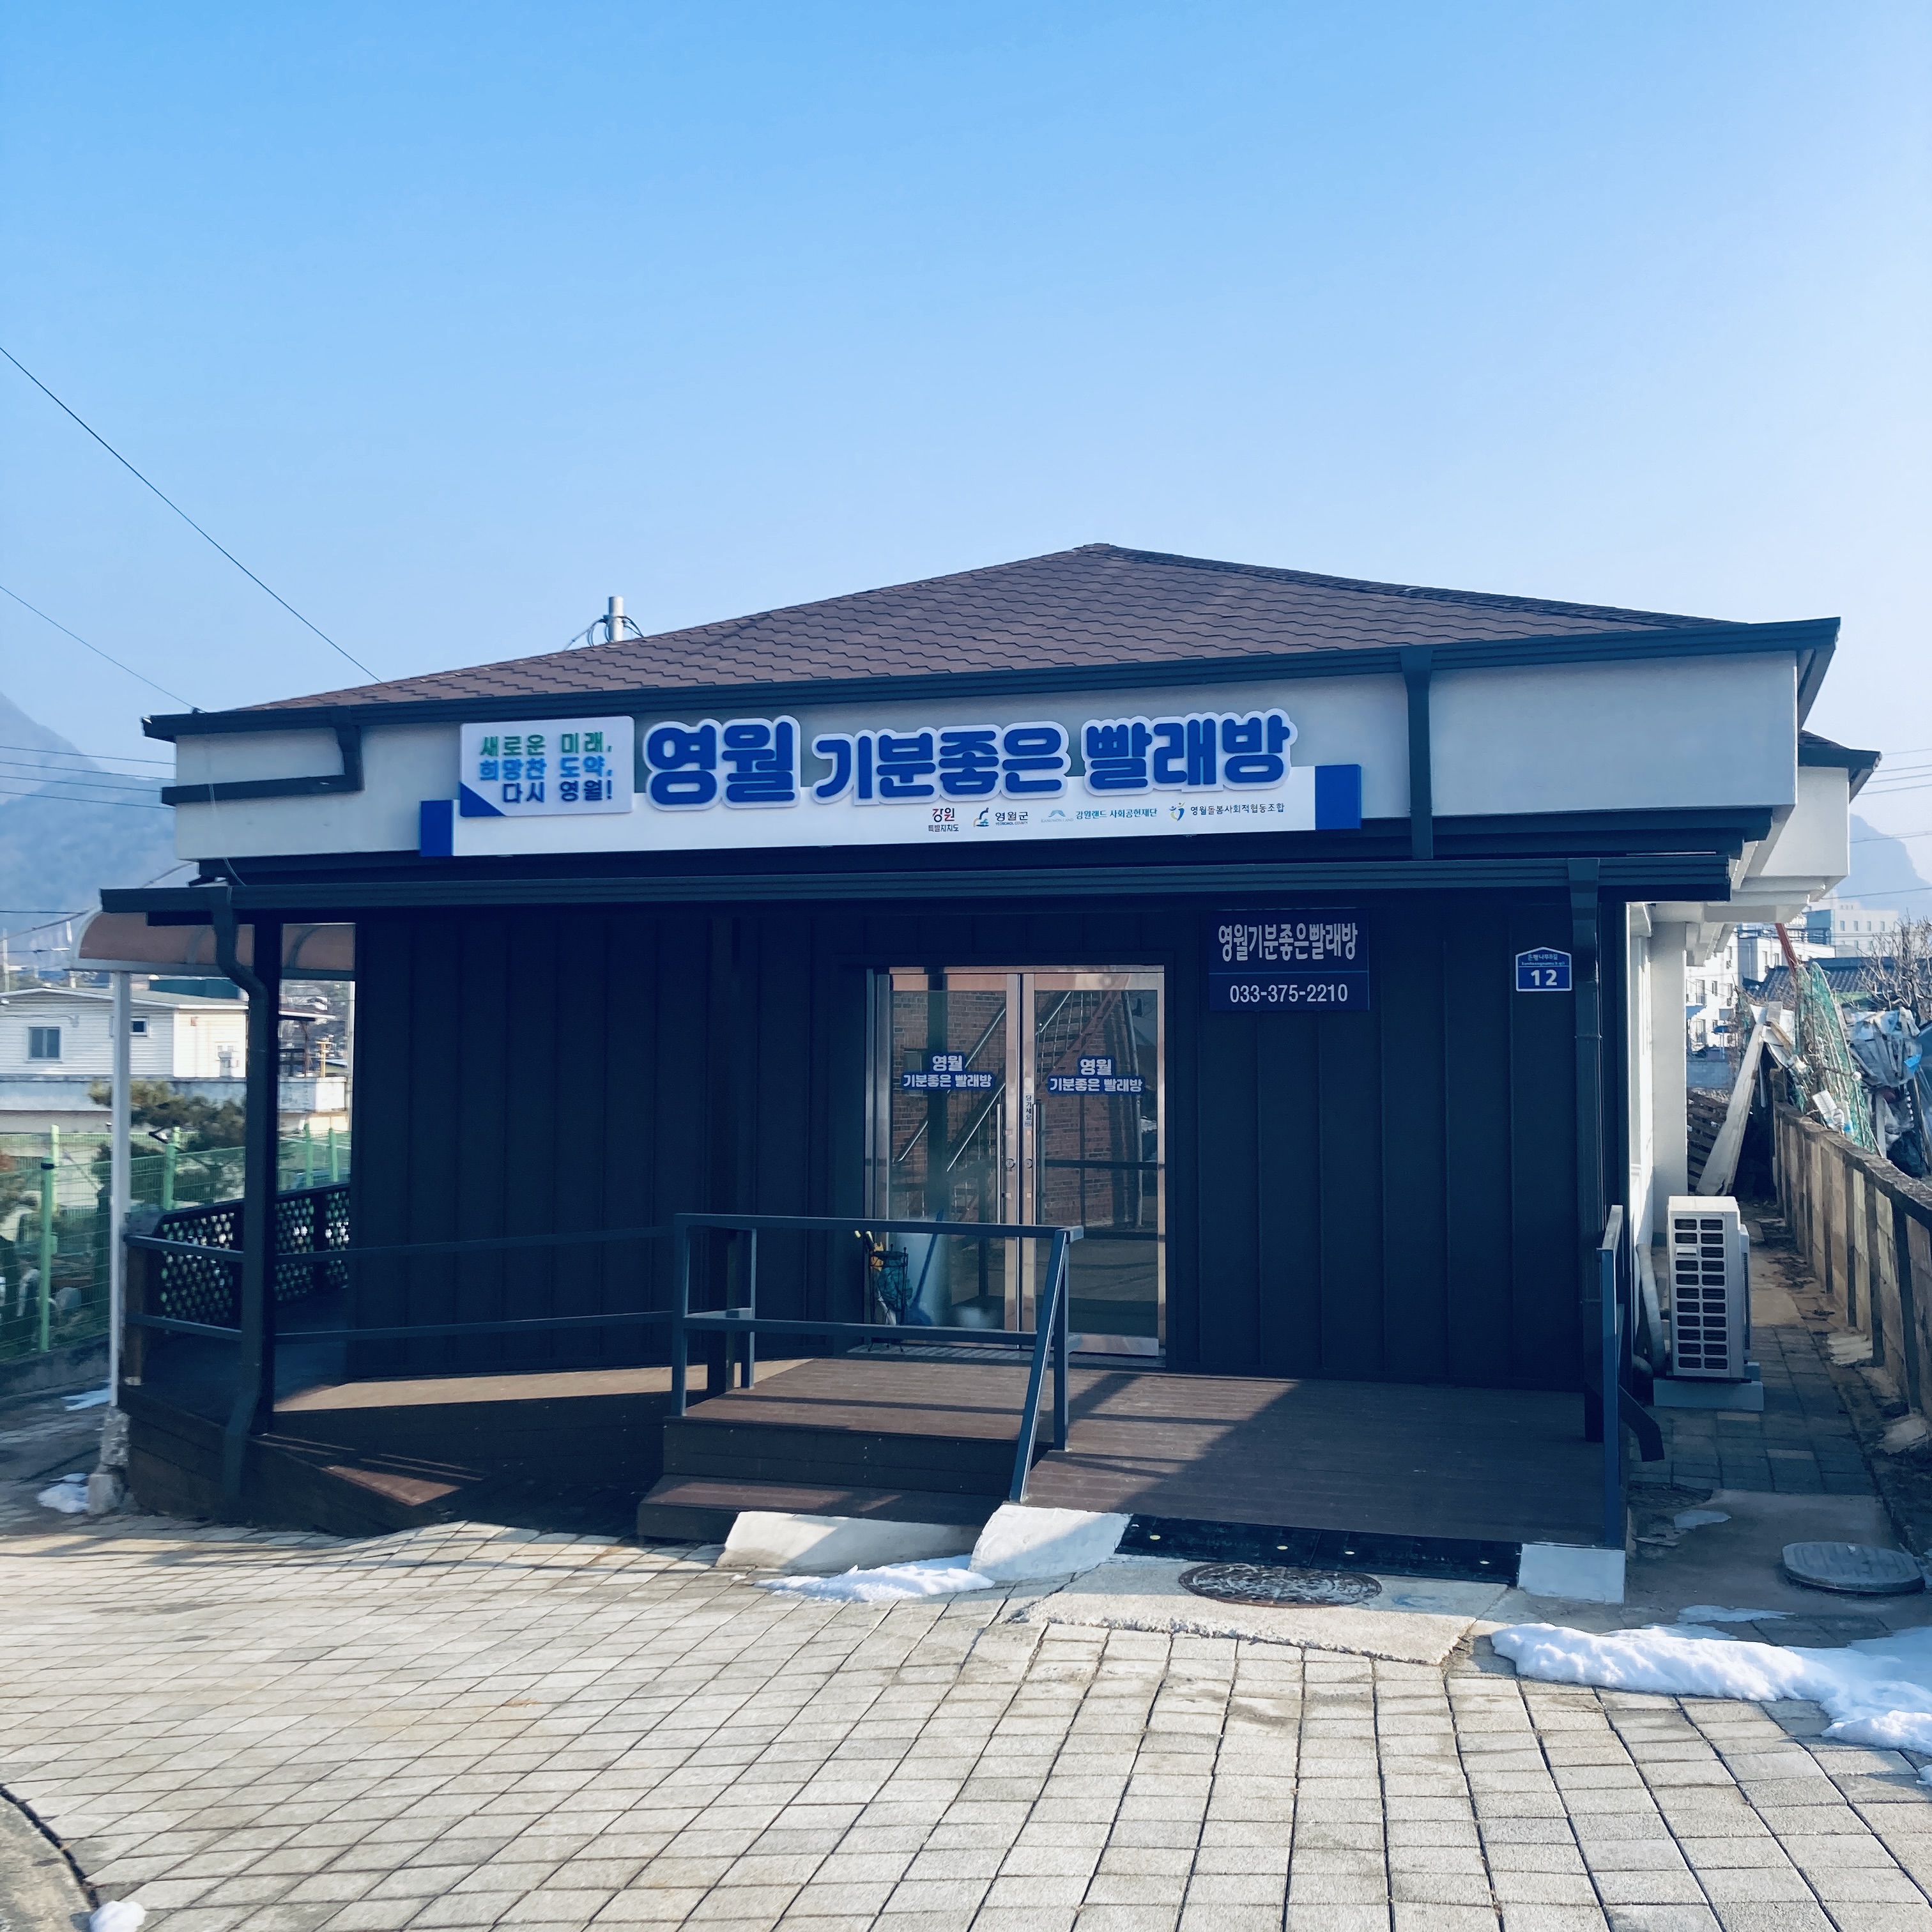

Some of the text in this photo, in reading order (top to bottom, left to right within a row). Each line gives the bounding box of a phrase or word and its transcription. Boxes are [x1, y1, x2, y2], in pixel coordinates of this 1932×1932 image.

[480, 732, 612, 756] 새로운 미래,
[480, 755, 612, 781] 희망찬 도약,
[647, 714, 1291, 806] 영월 기분좋은 빨래방
[503, 779, 612, 803] 다시 영월!
[932, 808, 955, 823] 강원
[995, 811, 1029, 822] 영월군
[1076, 808, 1158, 820] 강원랜드 사회공헌재단
[1190, 802, 1285, 816] 영월돌봄사회적협동조합
[1218, 922, 1358, 962] 영월기분좋은빨래방
[1530, 969, 1558, 986] 12
[1229, 984, 1348, 1003] 033-375-2210
[932, 1055, 963, 1071] 영월
[1080, 1059, 1112, 1076] 영월
[903, 1074, 992, 1087] 기분좋은 빨래방
[1050, 1078, 1143, 1092] 기분좋은 빨래방
